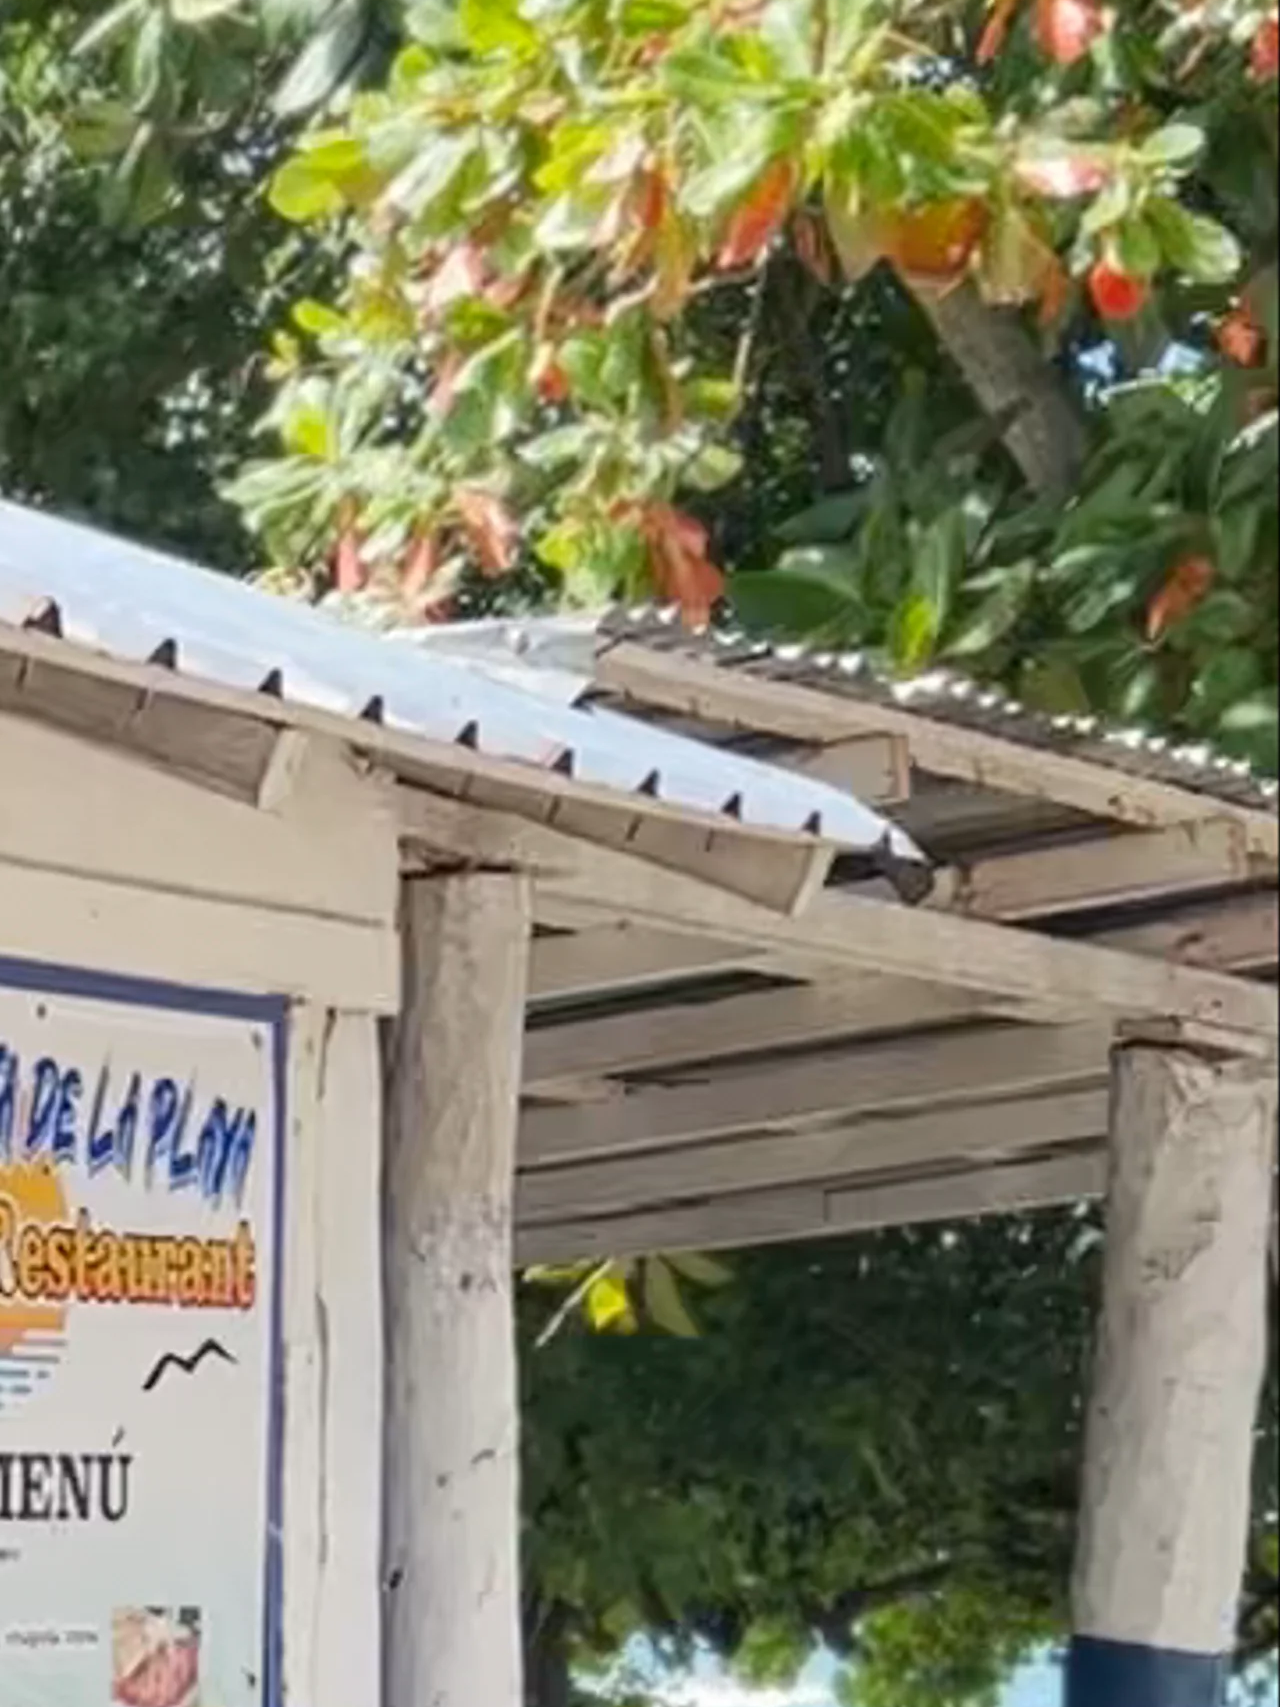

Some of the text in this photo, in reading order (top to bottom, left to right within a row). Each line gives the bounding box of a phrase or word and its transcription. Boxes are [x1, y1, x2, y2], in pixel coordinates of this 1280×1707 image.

[26, 1057, 82, 1165] DE
[88, 1057, 142, 1183] LA
[144, 1069, 257, 1208] PLAYA
